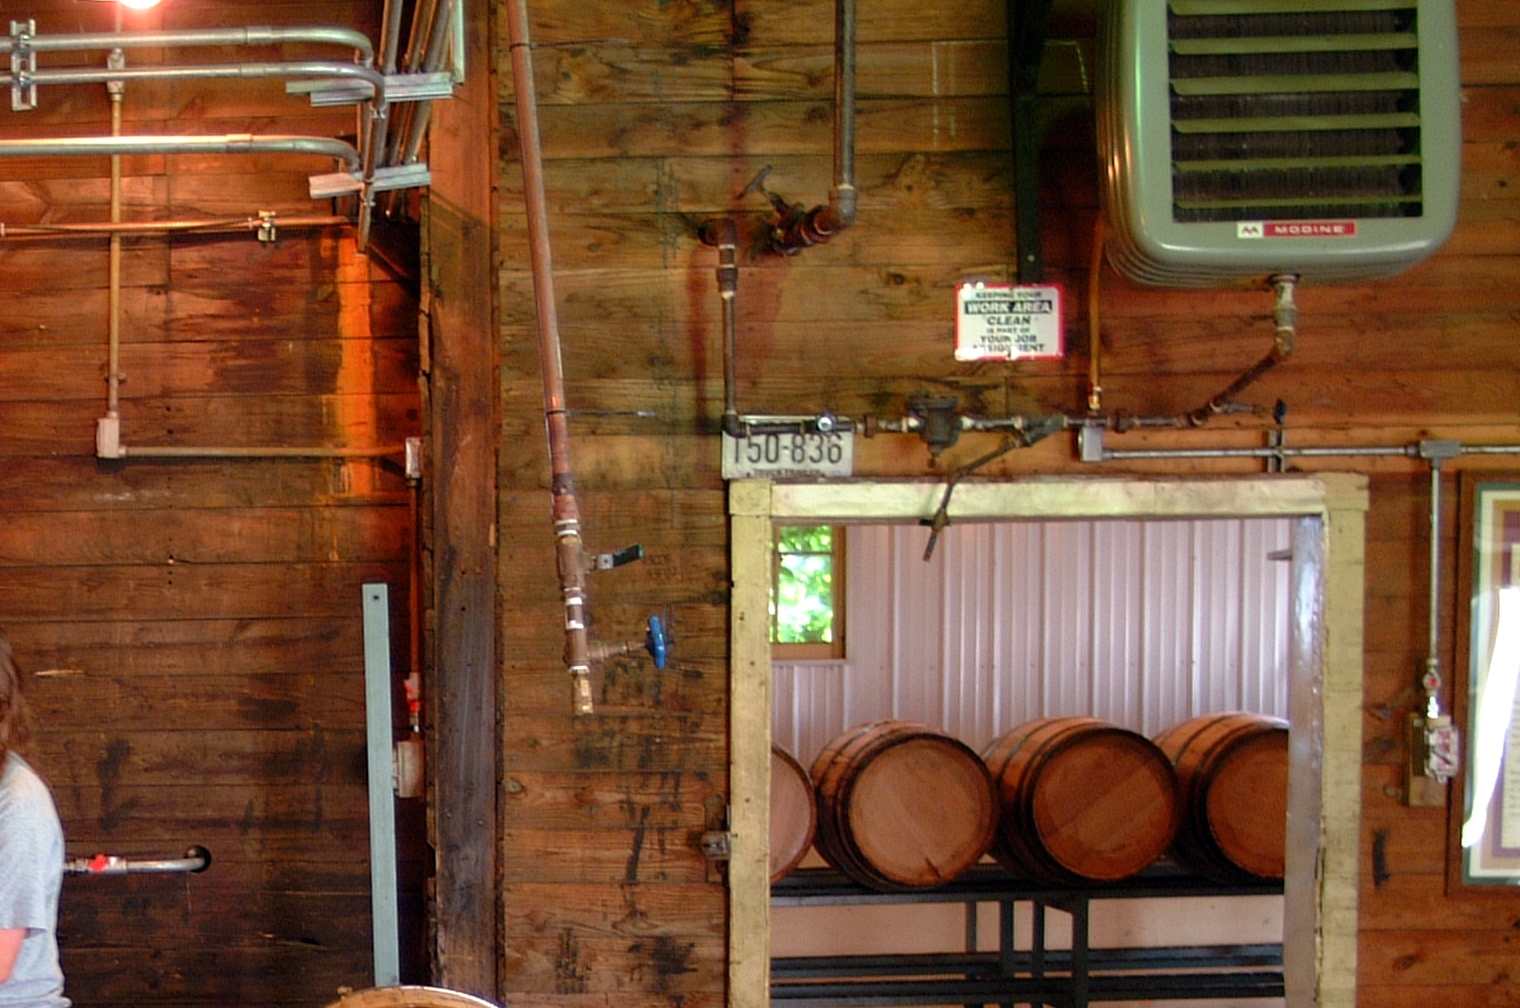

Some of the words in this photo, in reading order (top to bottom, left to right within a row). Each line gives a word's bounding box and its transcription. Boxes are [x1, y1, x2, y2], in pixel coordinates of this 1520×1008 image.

[1274, 225, 1345, 235] MODINE
[968, 302, 1009, 313] WORK
[1012, 302, 1050, 313] AREA
[987, 316, 1031, 325] CLEAN
[973, 344, 1045, 352] SIGMENT
